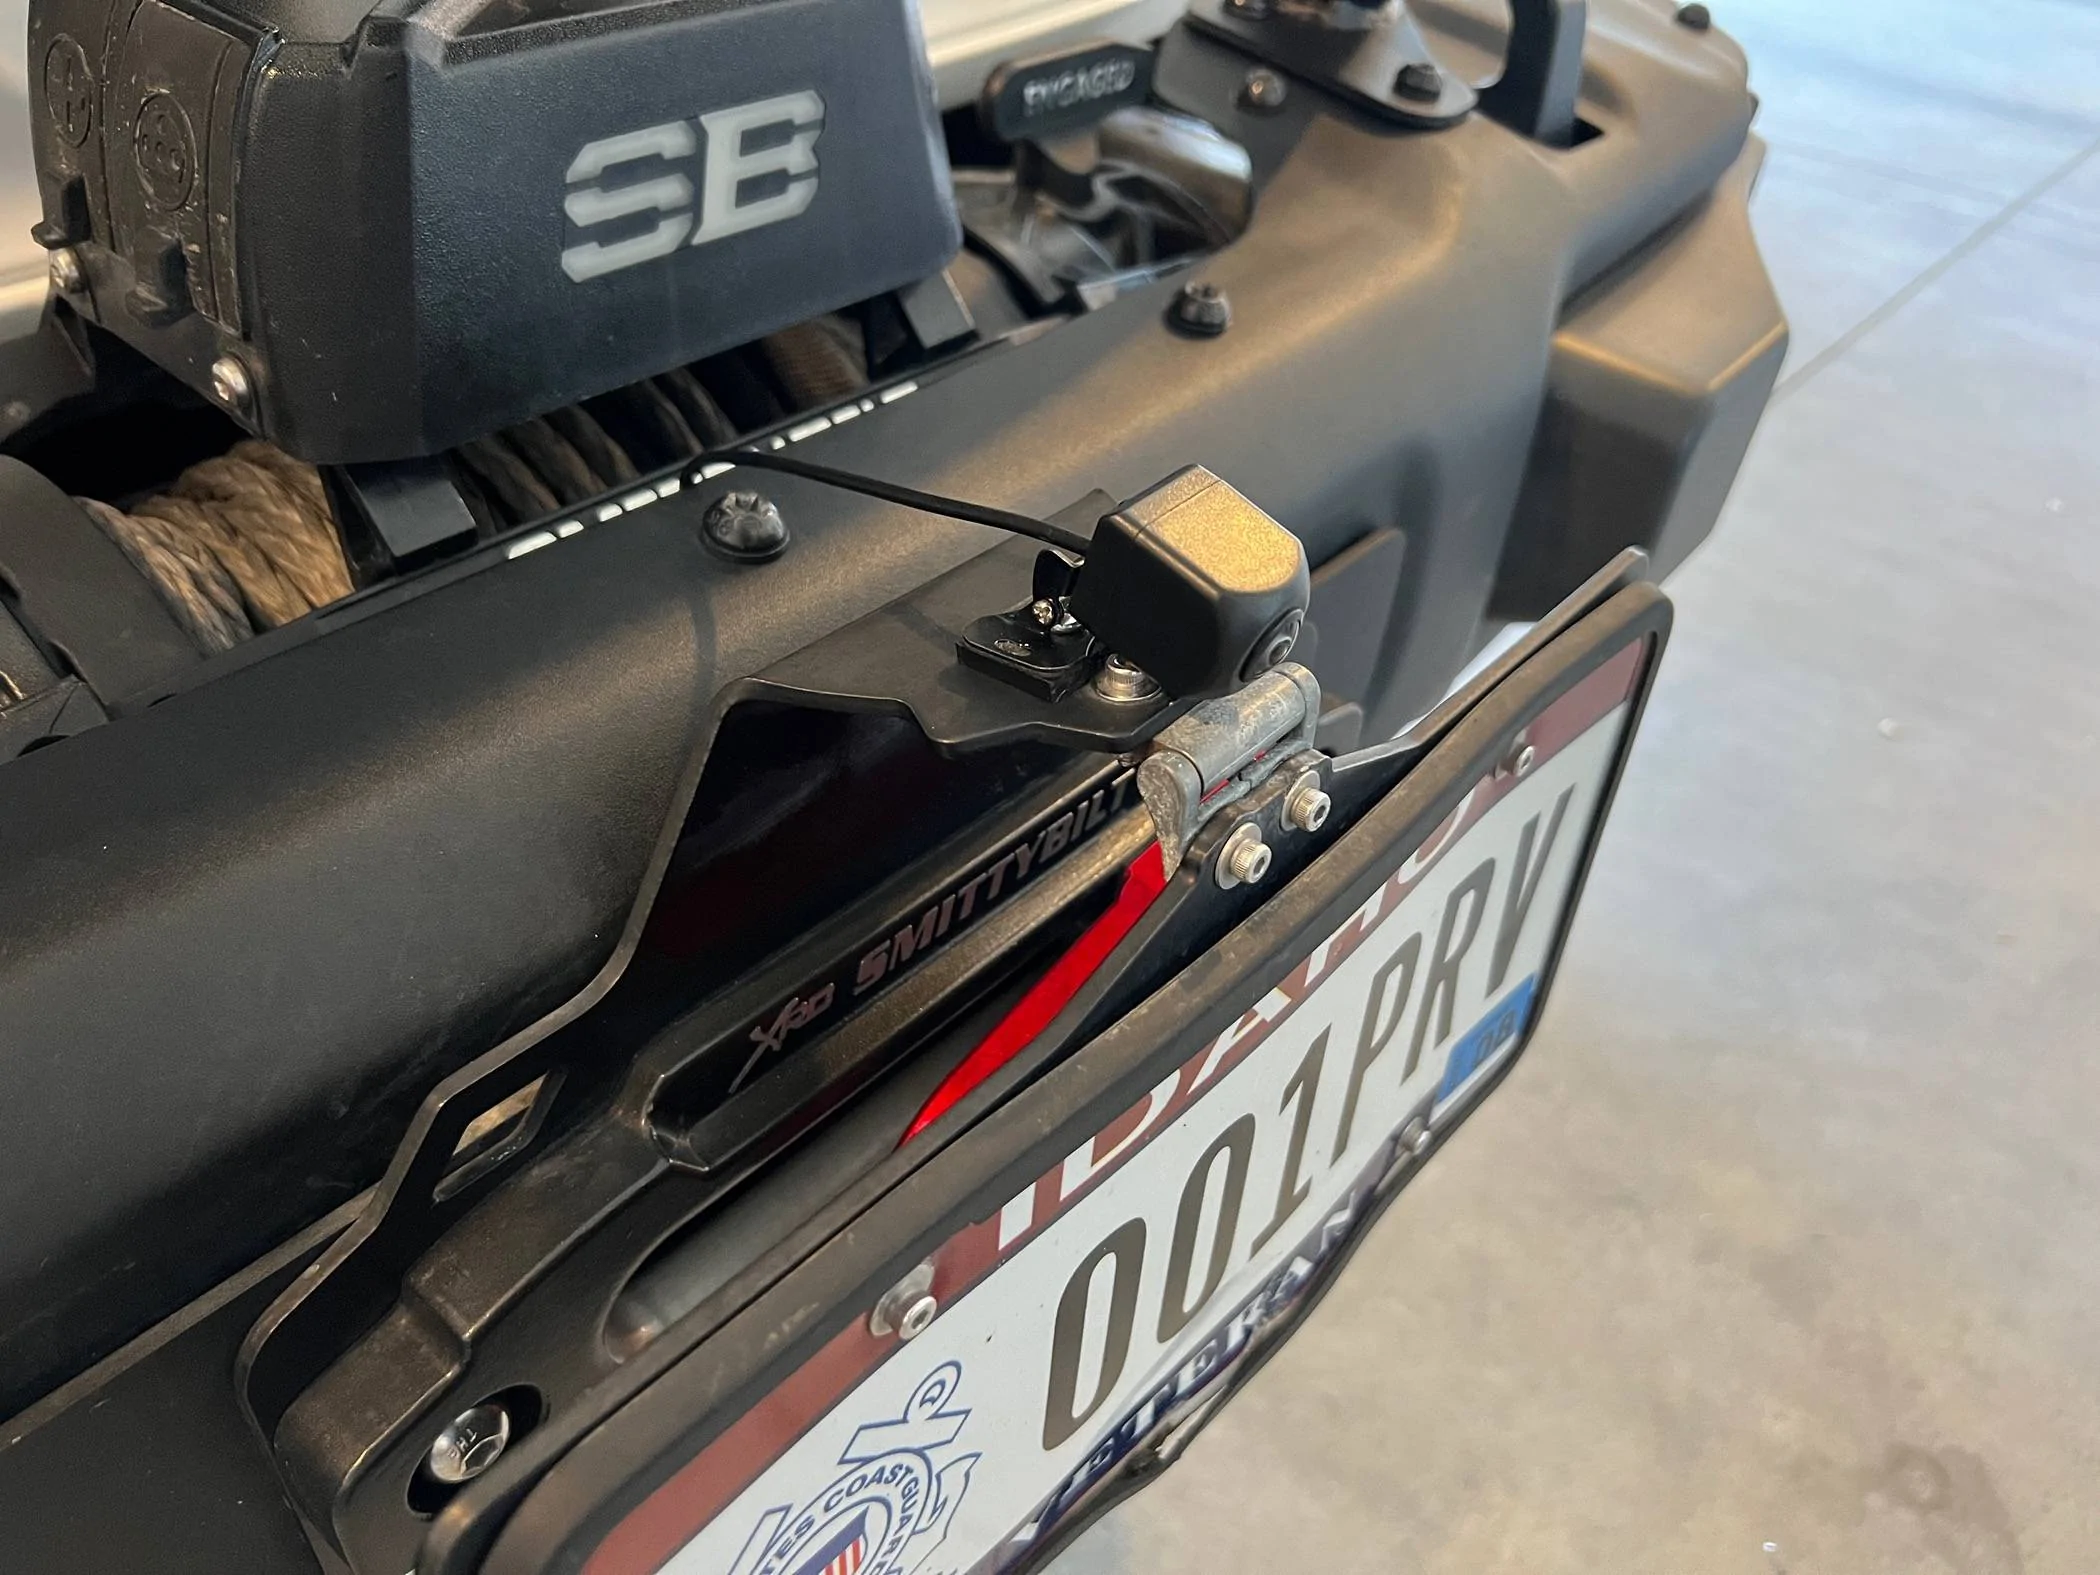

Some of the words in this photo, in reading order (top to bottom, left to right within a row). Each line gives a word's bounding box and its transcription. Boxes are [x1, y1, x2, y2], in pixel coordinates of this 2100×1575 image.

[561, 89, 827, 284] SB
[852, 767, 1136, 998] SMITTYBILT
[1042, 782, 1577, 1452] 001PRV
[823, 1463, 914, 1513] COAST
